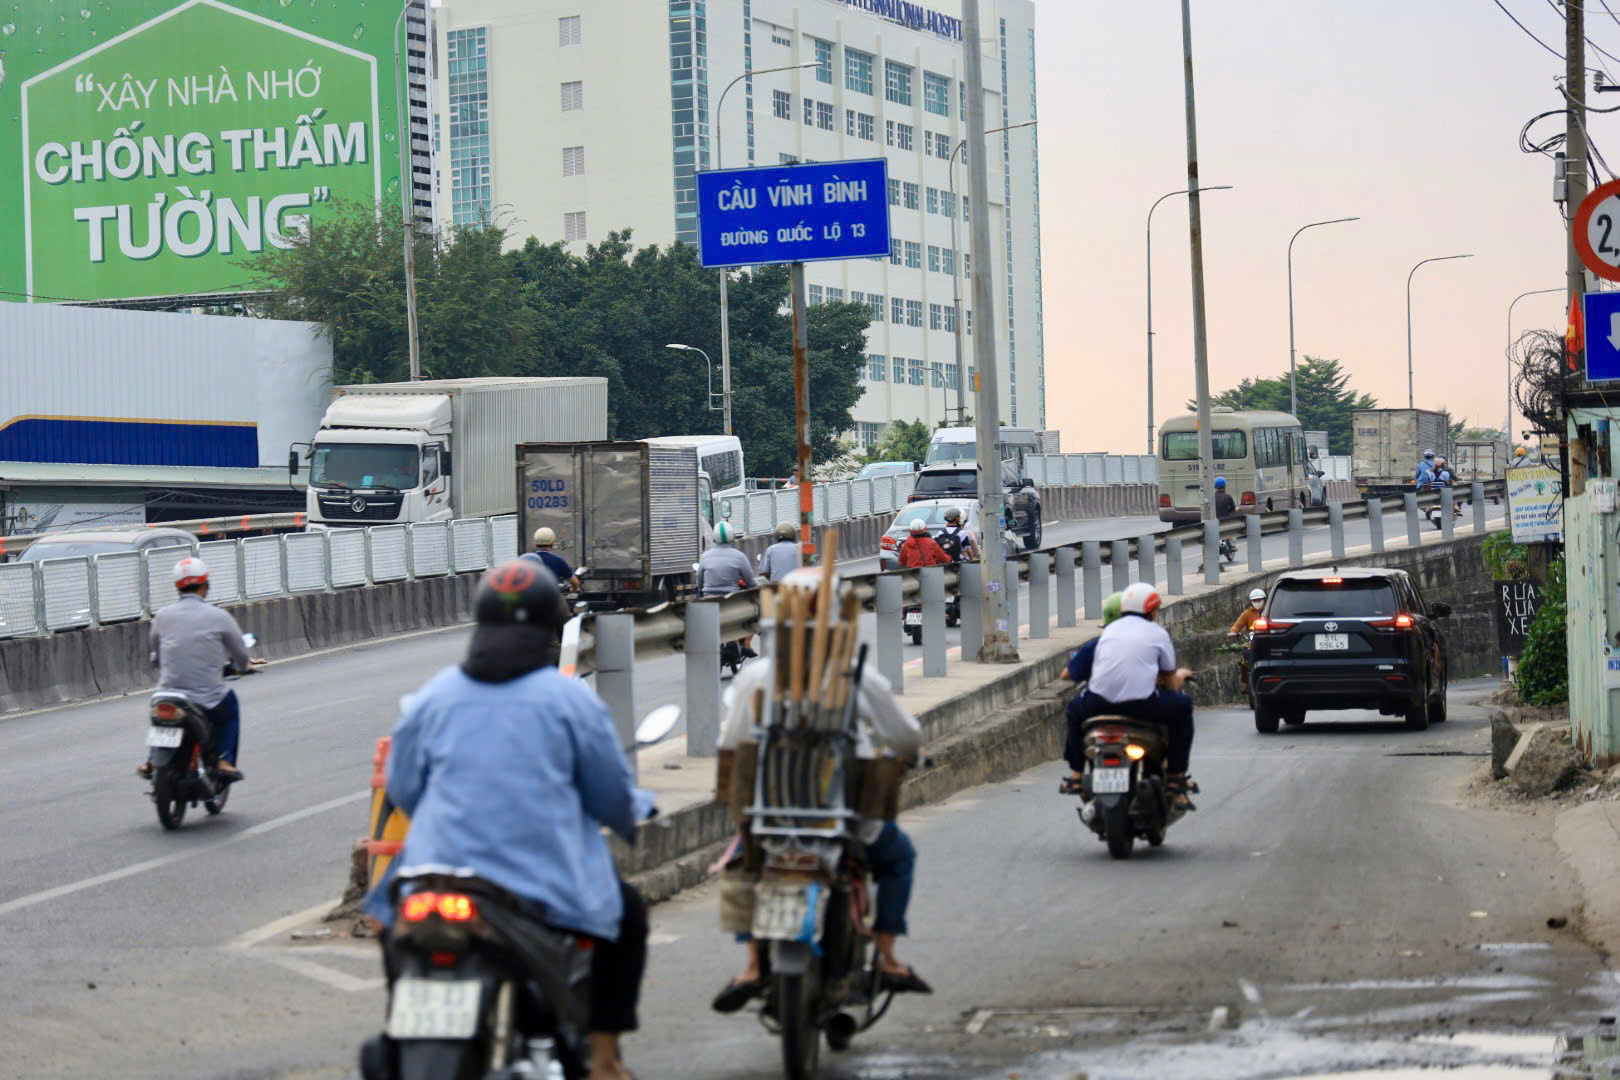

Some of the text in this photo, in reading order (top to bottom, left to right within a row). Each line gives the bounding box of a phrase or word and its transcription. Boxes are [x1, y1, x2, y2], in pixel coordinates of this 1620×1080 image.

[167, 65, 238, 107] NHÀ
[35, 107, 366, 184] CHỐNG THẤM
[718, 174, 867, 211] CẦU VĨNH BÌNH
[720, 220, 866, 247] ĐƯỜNG QUỐC LỘ 13
[1597, 213, 1620, 258] 2,
[531, 479, 566, 492] 50LD
[527, 495, 569, 509] 00283
[1507, 616, 1529, 635] XE
